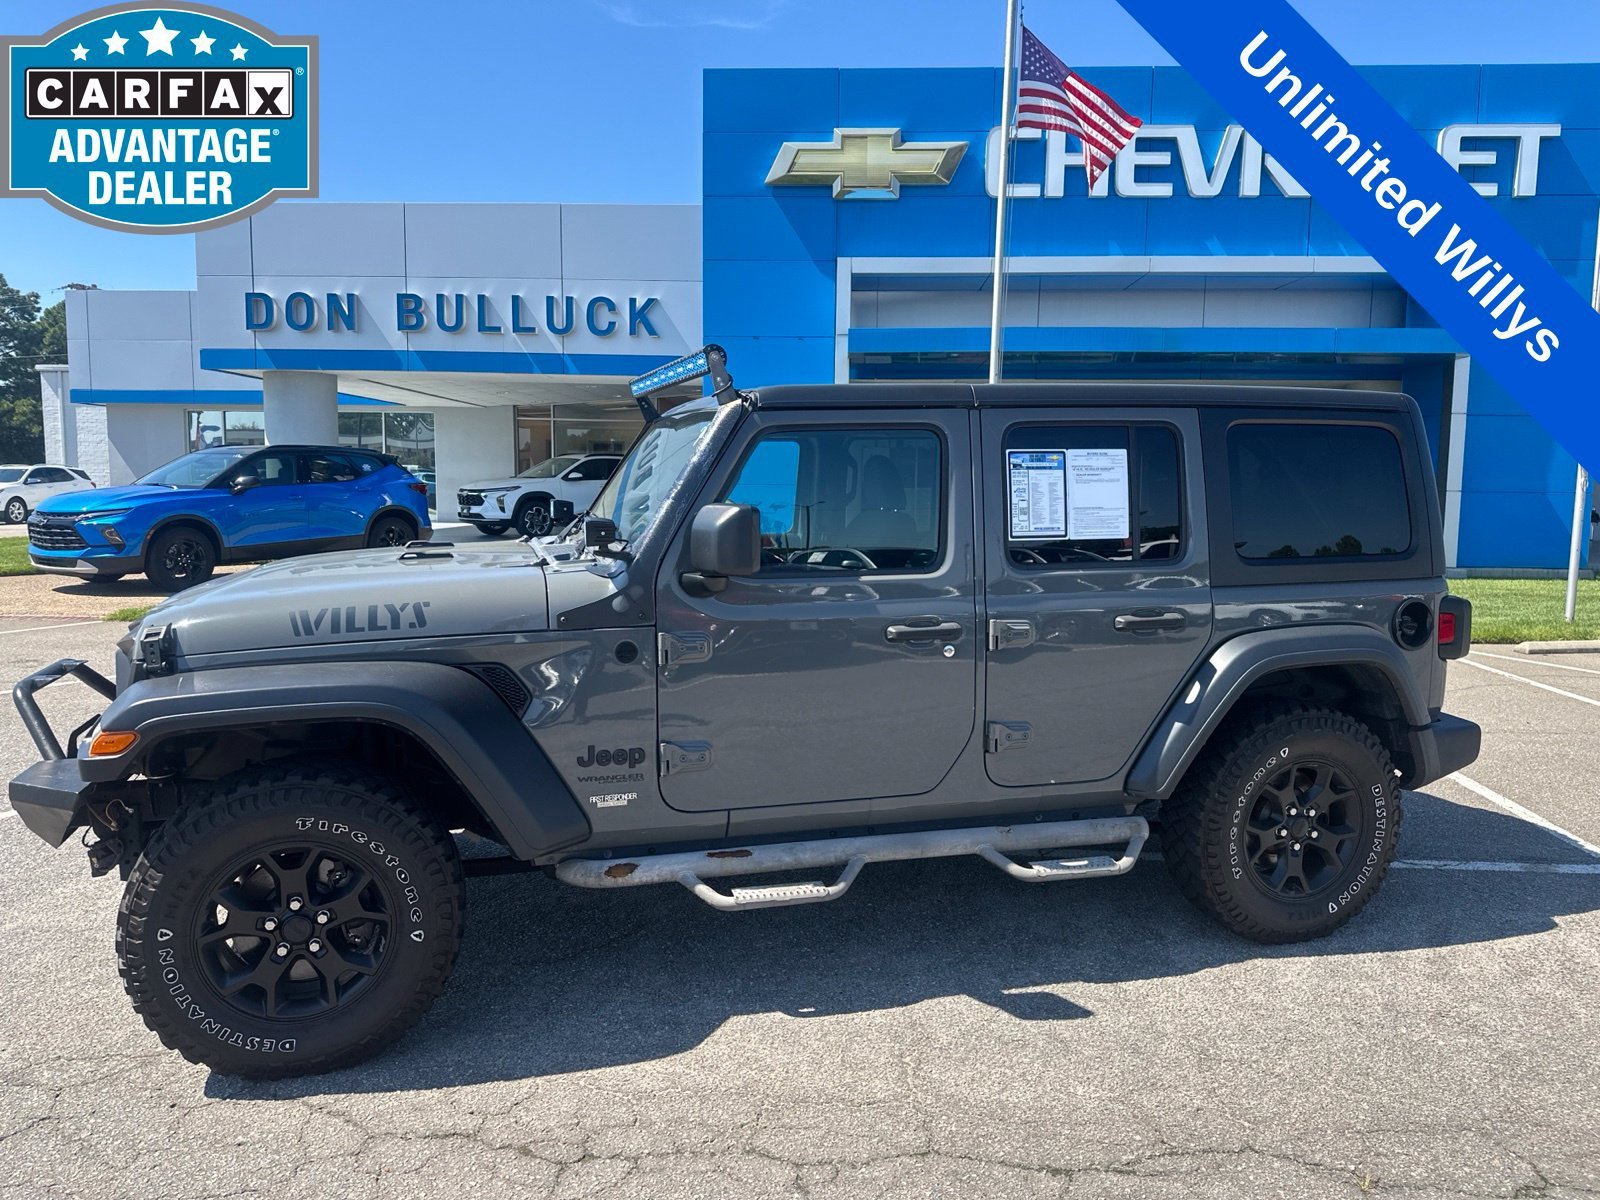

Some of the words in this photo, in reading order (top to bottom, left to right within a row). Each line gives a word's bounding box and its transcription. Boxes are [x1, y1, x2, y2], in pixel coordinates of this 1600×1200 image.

[245, 291, 357, 332] DON
[396, 293, 659, 338] BULLUCK
[289, 601, 431, 638] WILLYS
[577, 745, 646, 768] Jeep
[577, 773, 644, 783] WRANGLER
[589, 795, 604, 803] FIRST
[604, 792, 638, 801] RESPONDER
[1339, 784, 1387, 905] DESTINATION
[158, 948, 297, 1053] DESTINATION
